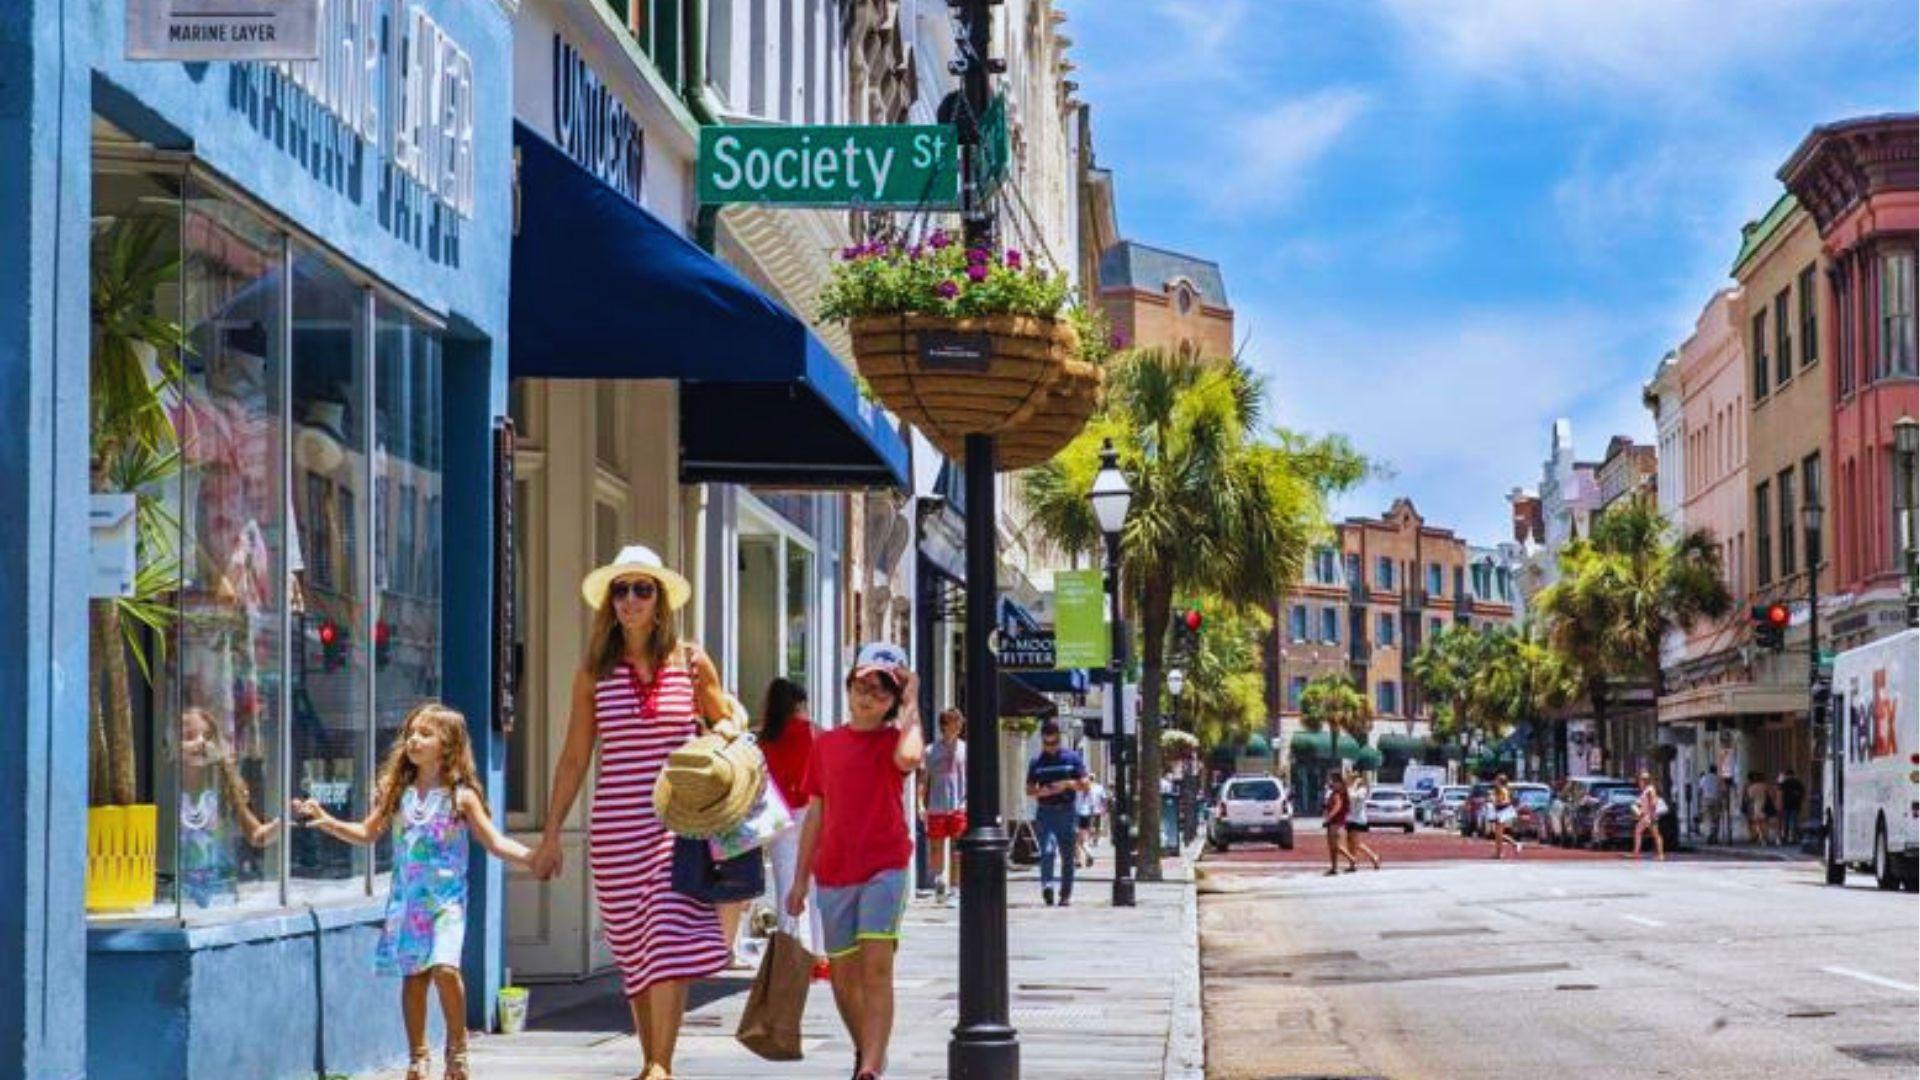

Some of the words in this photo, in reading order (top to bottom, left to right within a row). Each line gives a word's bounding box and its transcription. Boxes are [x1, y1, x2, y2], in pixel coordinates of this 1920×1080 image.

[169, 23, 227, 42] MARINE
[231, 23, 275, 42] LAYER
[712, 135, 895, 199] Society
[912, 133, 947, 168] St
